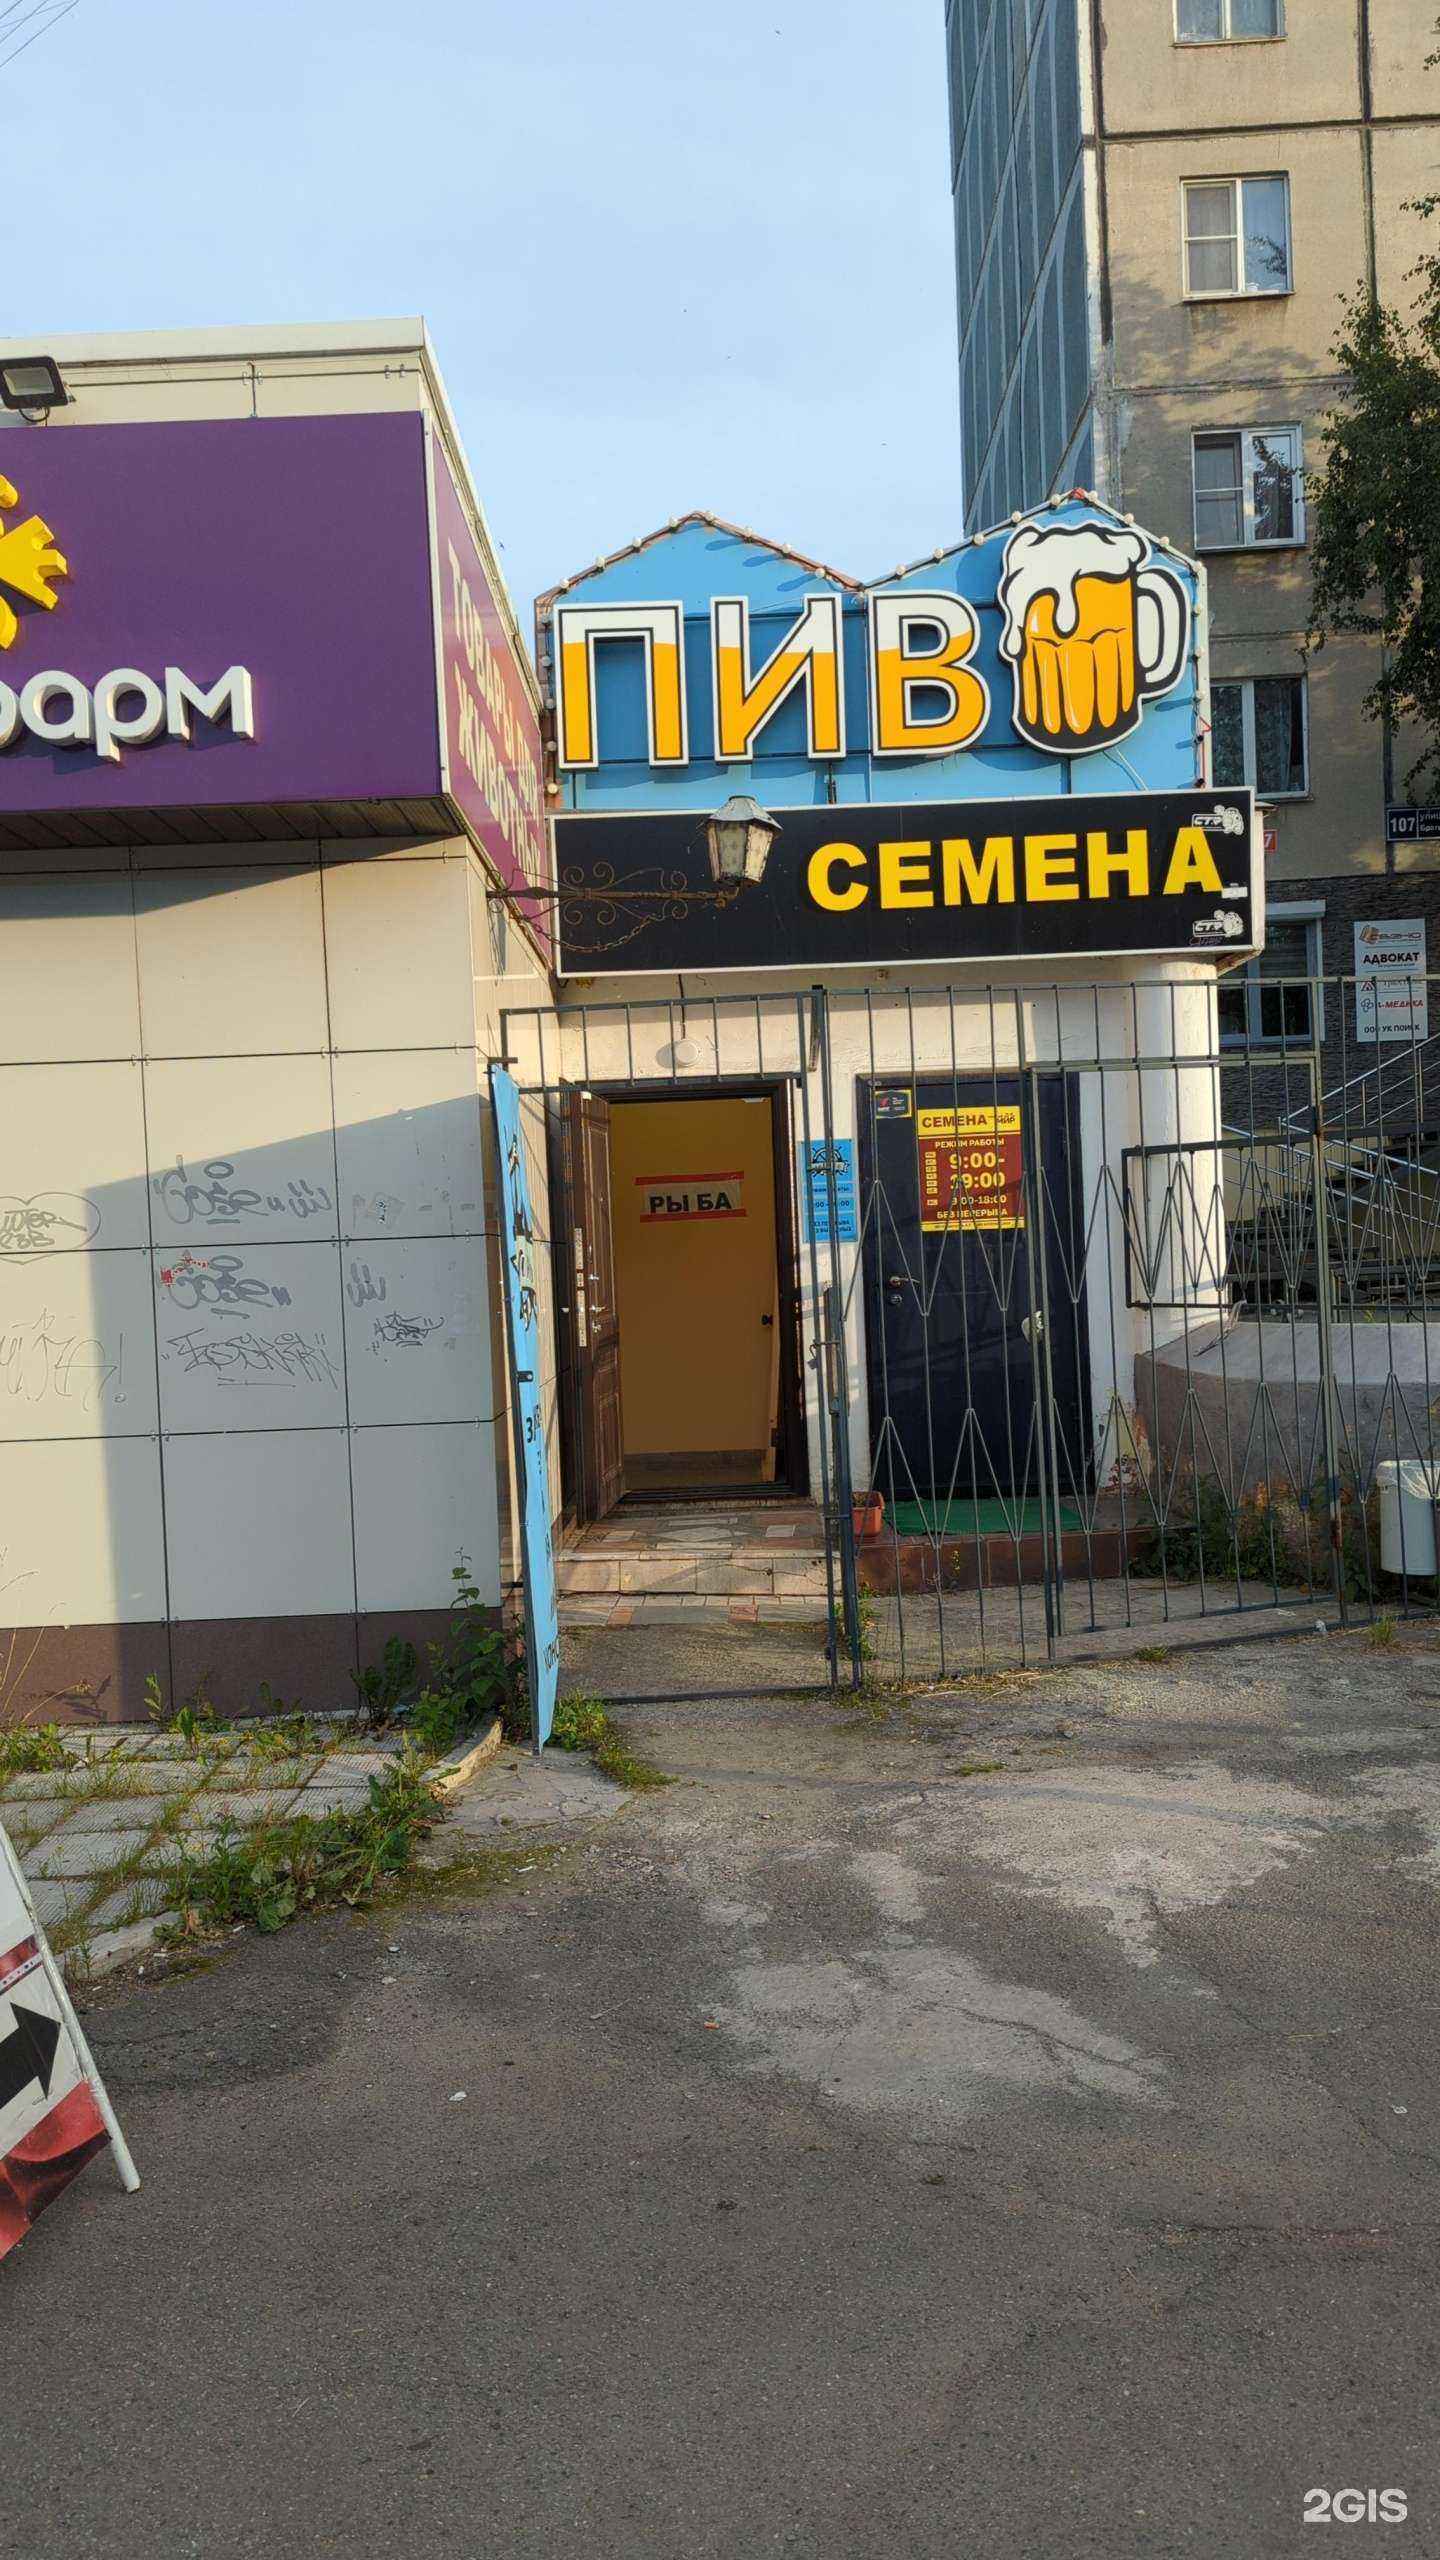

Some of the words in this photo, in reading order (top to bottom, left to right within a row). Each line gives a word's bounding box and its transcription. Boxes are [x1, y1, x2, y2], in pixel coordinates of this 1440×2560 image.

[448, 536, 516, 771] ТОВАРЫ
[1390, 817, 1415, 832] 107
[807, 826, 1223, 912] СЕМЕНА
[1363, 952, 1420, 965] АДВОКАТ
[1394, 1023, 1420, 1032] ПОИК
[922, 1114, 988, 1128] СЕМЕНА
[969, 1138, 1005, 1147] РАБОТЫ
